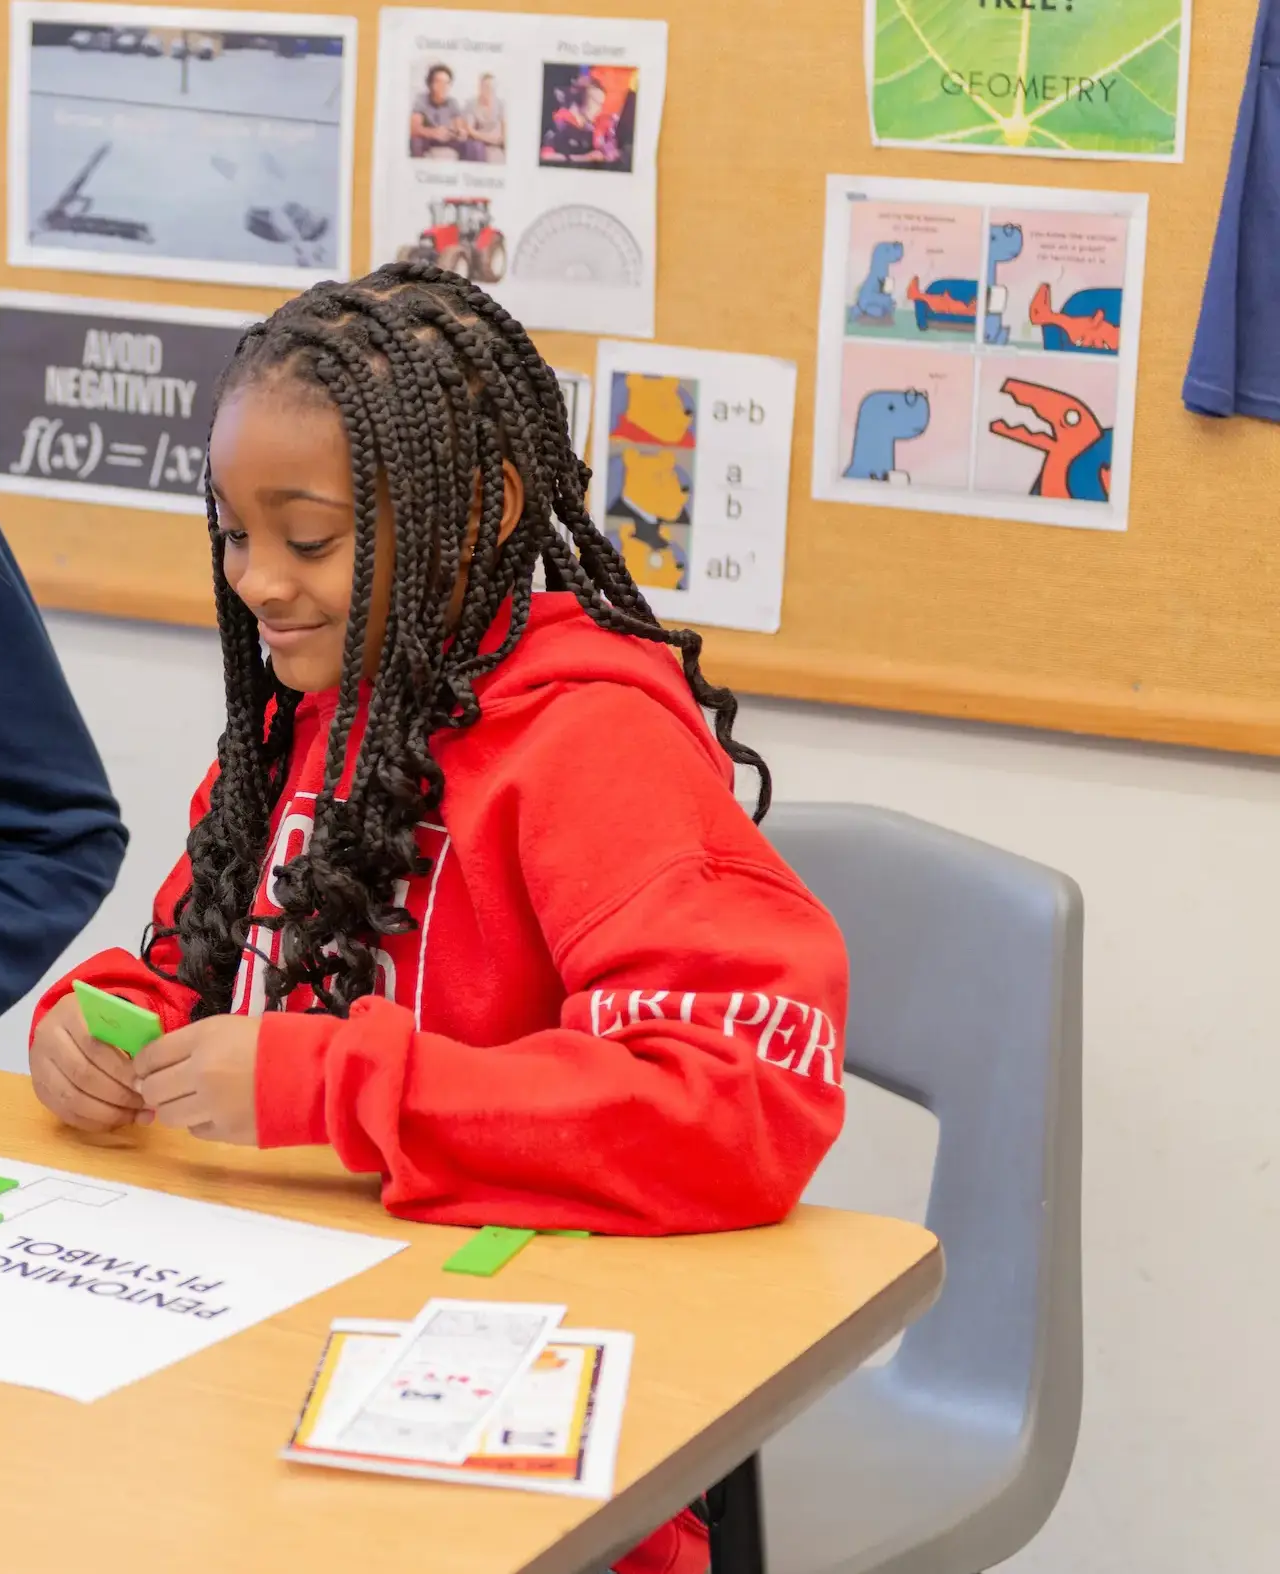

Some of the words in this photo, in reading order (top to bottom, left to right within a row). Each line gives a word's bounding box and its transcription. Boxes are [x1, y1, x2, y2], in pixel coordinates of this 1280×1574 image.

[940, 70, 1117, 103] GEOMETRY
[82, 328, 163, 374] AVOID
[44, 365, 197, 419] NEGATIVITY
[726, 464, 742, 484] a
[726, 493, 742, 520] b
[8, 1235, 179, 1283] SYMBOL
[176, 1275, 224, 1292] PI
